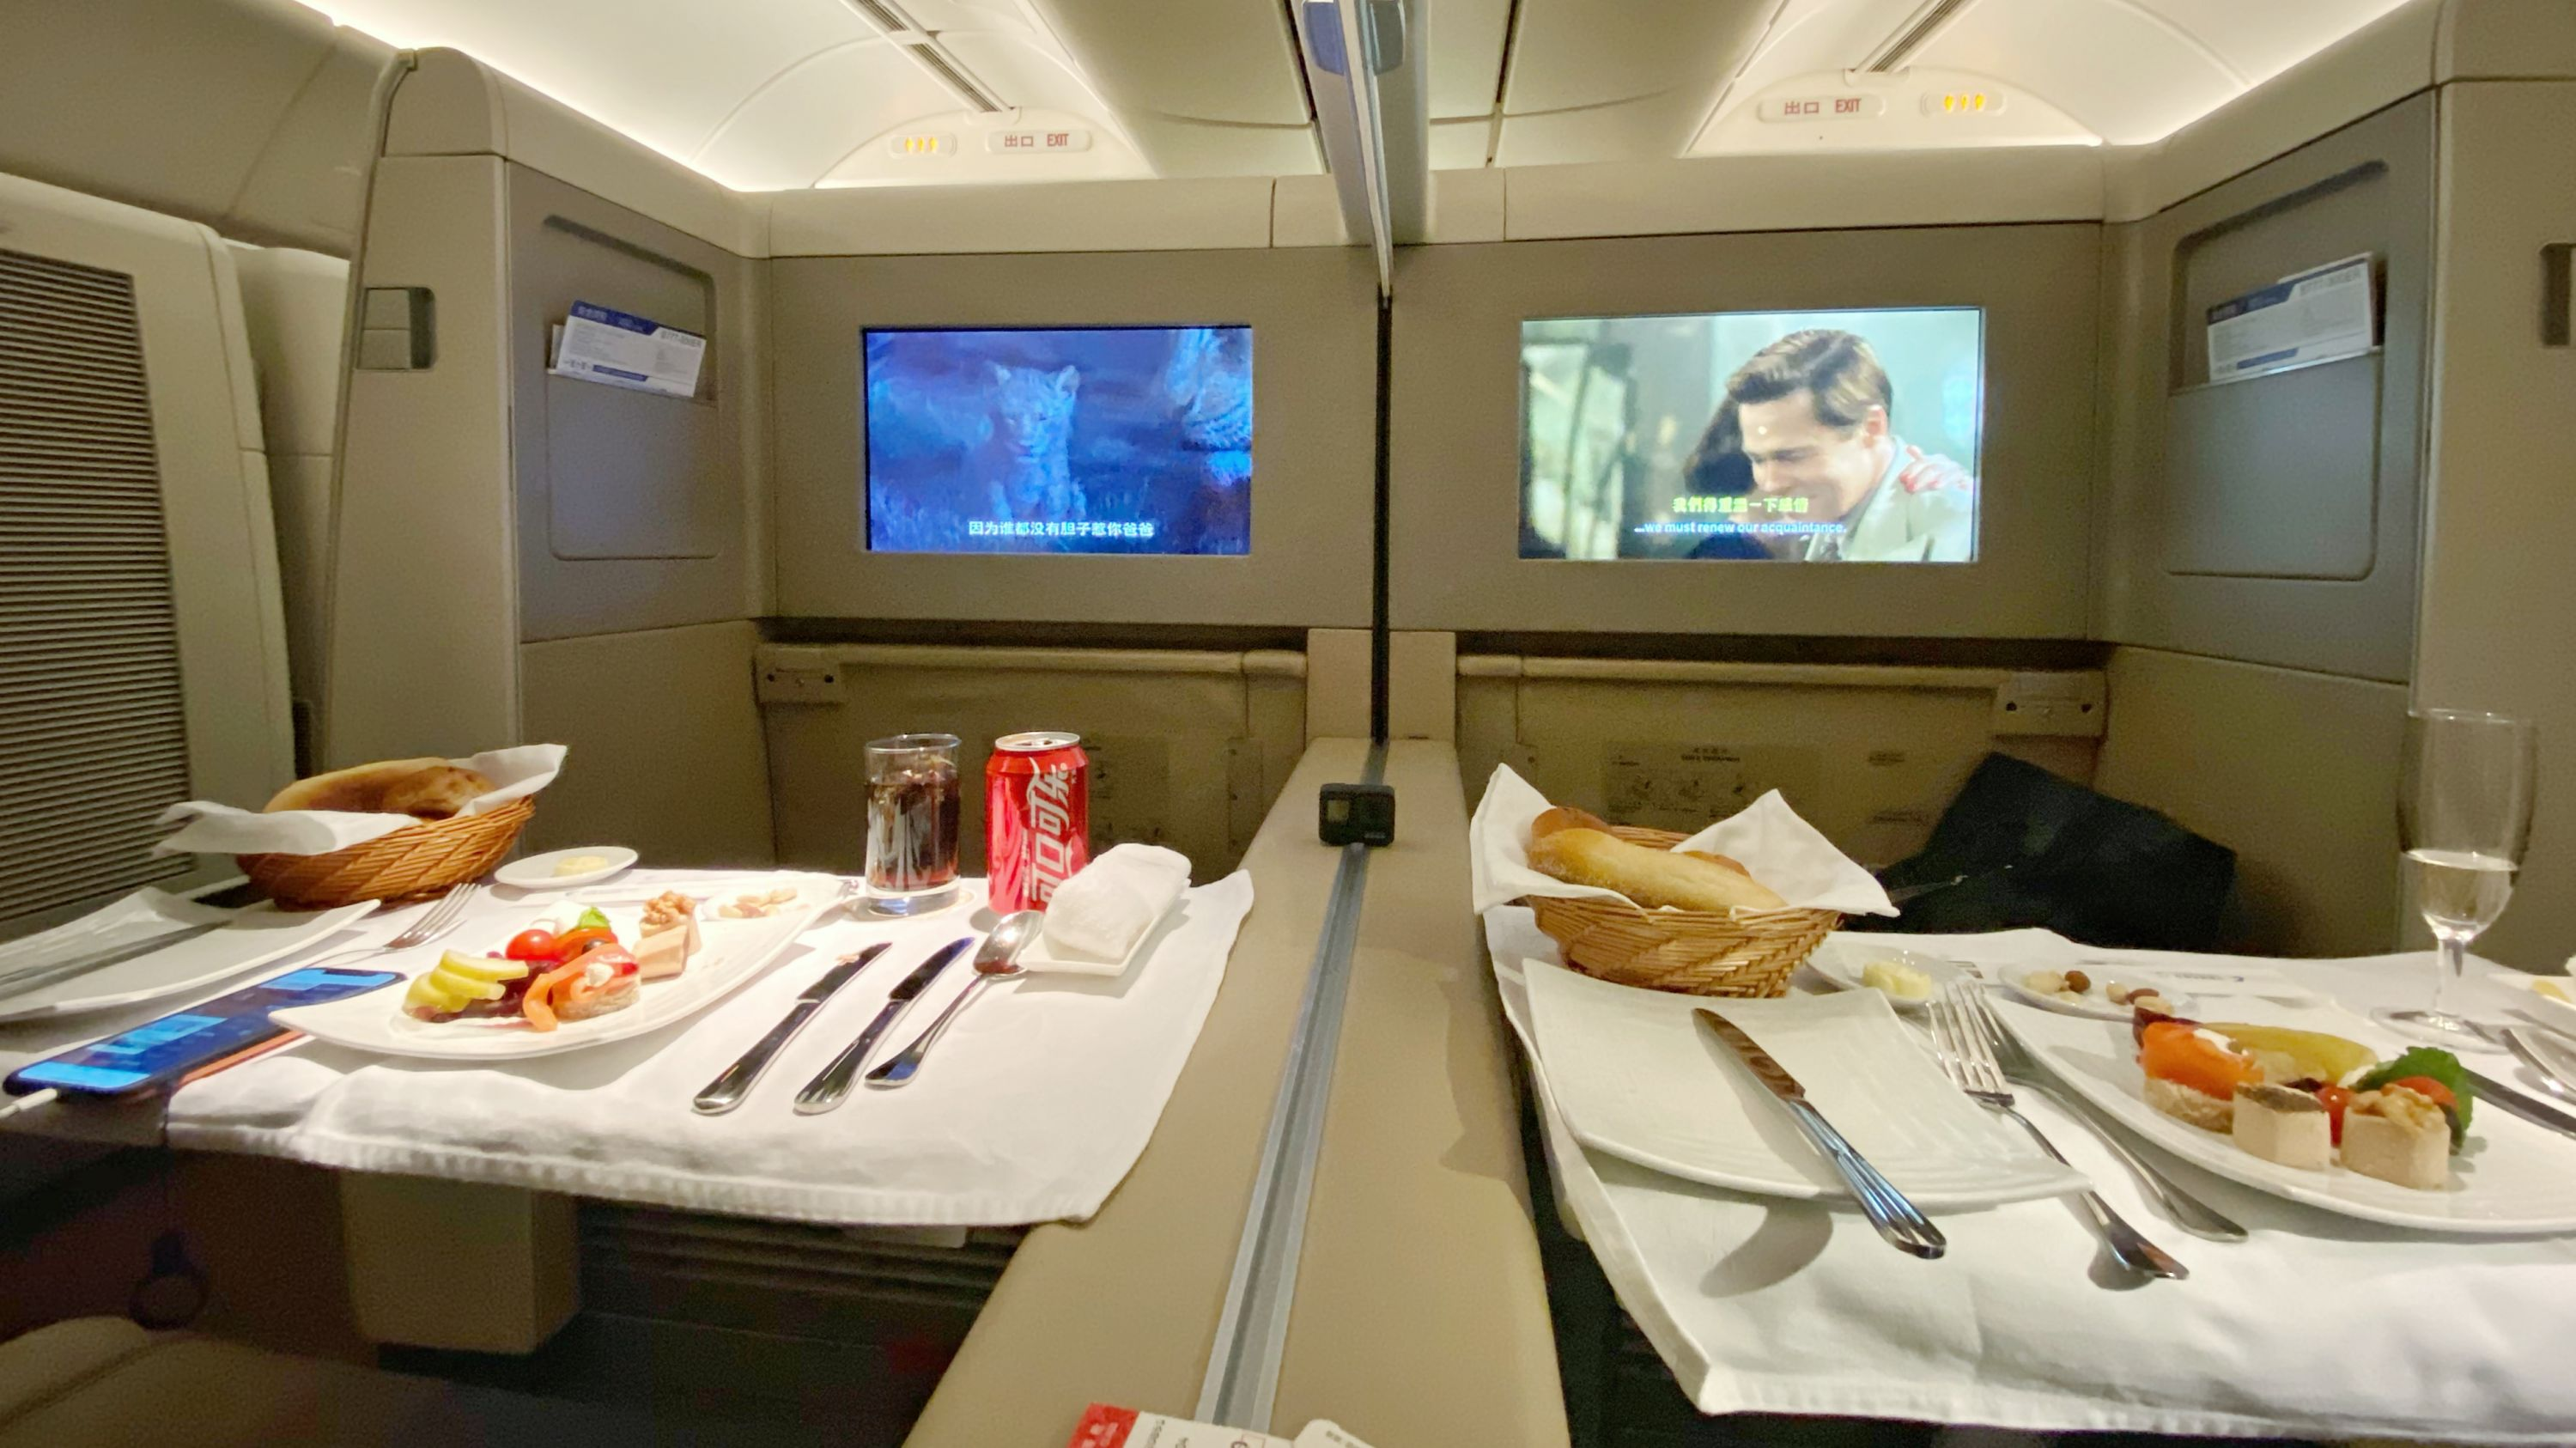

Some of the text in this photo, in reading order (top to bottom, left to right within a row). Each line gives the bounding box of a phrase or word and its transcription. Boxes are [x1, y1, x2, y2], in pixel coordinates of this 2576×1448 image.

[1783, 98, 1862, 115] 出口 EXIT
[1004, 132, 1069, 148] 出口 EXIT
[1664, 522, 1696, 533] must
[1697, 523, 1735, 533] renew
[1736, 523, 1759, 533] our
[1760, 522, 1848, 536] acquaintance.
